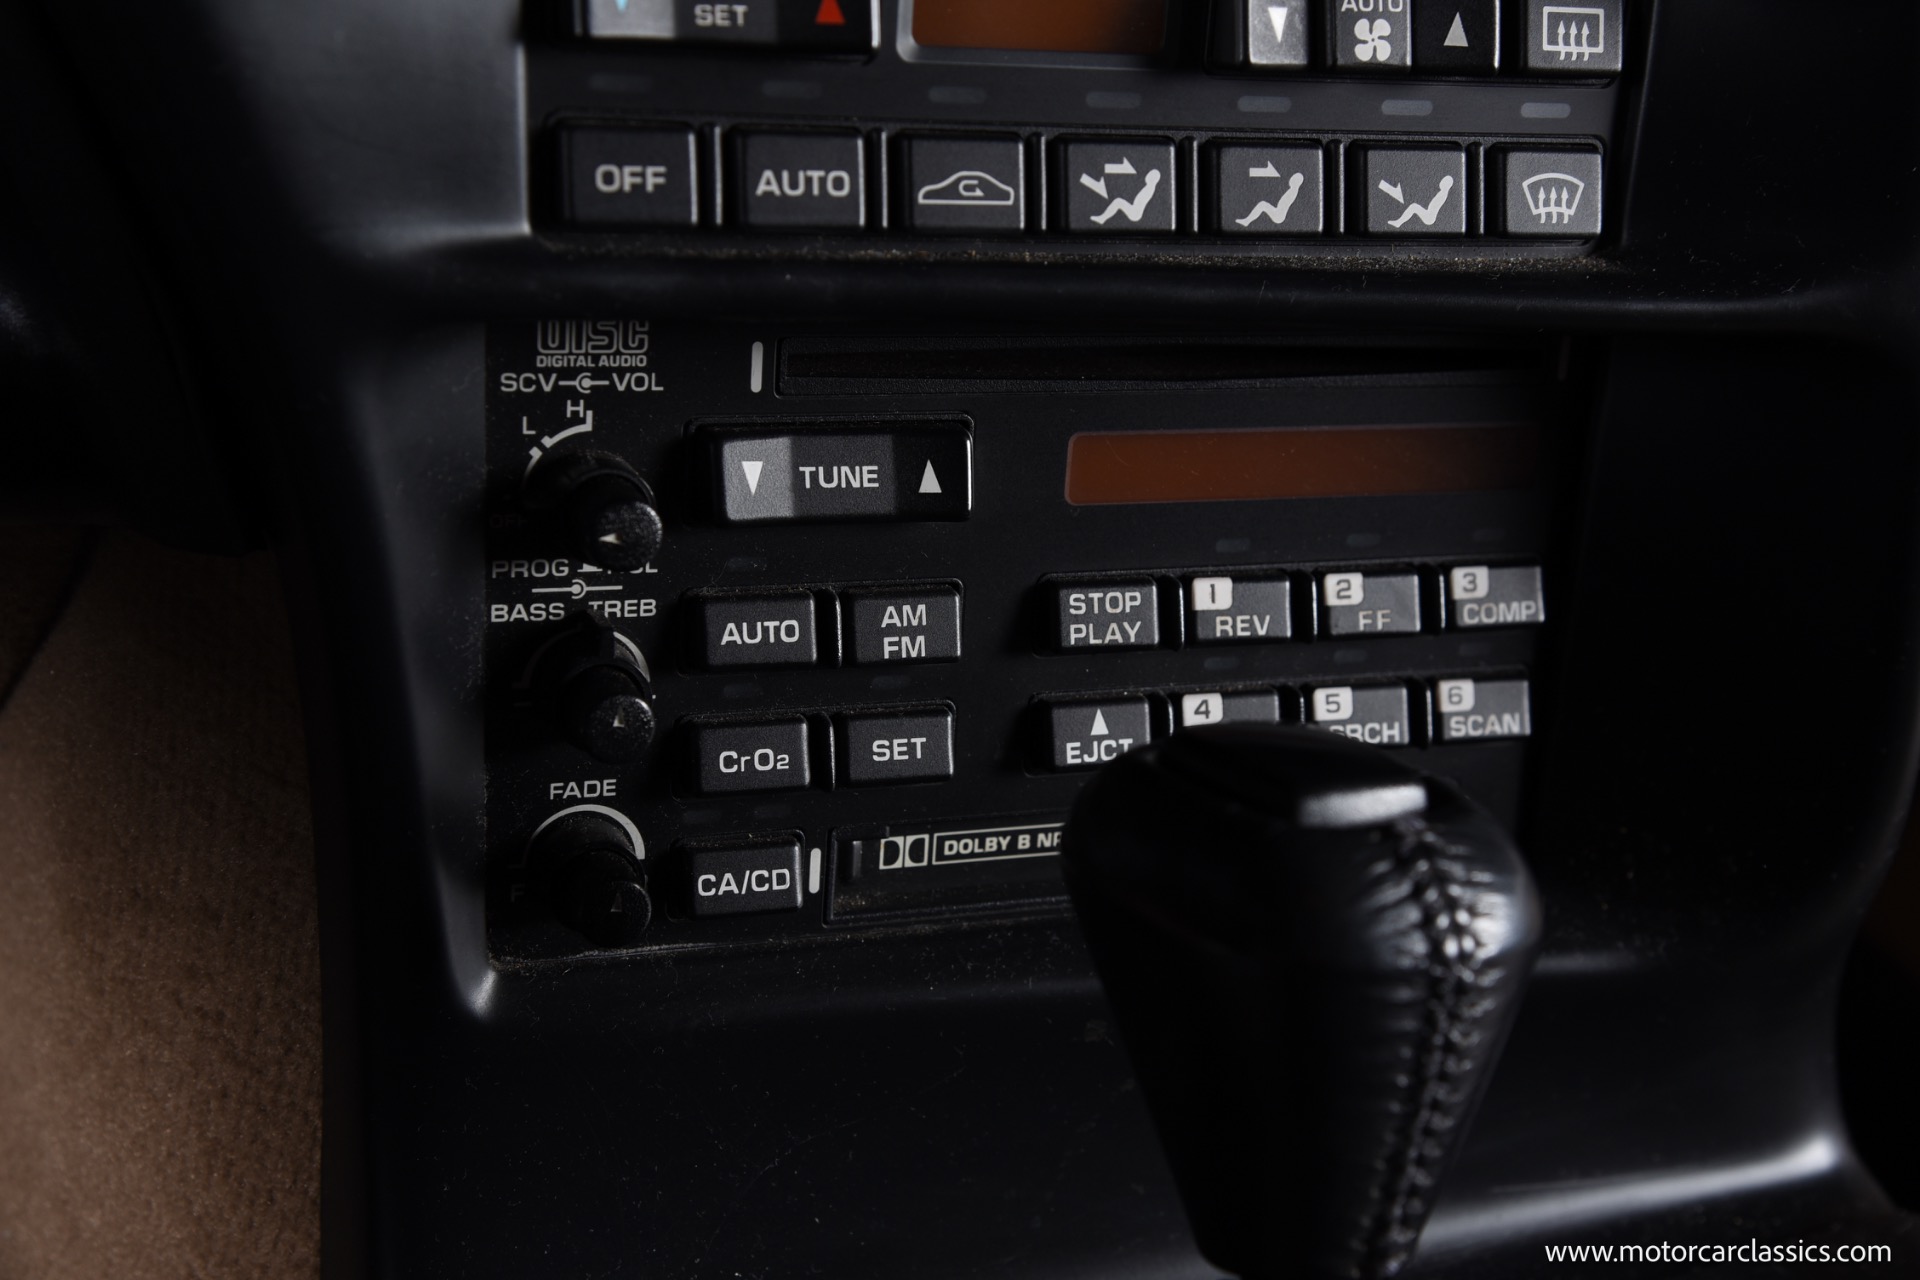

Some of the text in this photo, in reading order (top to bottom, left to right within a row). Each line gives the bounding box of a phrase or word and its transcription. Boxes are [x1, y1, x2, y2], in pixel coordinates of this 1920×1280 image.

[694, 4, 749, 27] SET
[594, 164, 667, 193] OFF
[755, 169, 851, 197] AUTO
[536, 354, 648, 368] DIGITAL AUDIO
[500, 372, 664, 392] SCV VOL
[566, 399, 584, 418] H
[522, 415, 536, 435] L
[799, 465, 879, 489] TUNE
[491, 558, 570, 579] PROG
[1210, 583, 1216, 604] 1
[1336, 579, 1351, 600] 2
[1463, 572, 1478, 592] 3
[490, 602, 565, 623] BASS
[1069, 591, 1142, 615] STOP
[1463, 600, 1537, 624] COMP
[881, 604, 927, 628] AM
[1215, 615, 1270, 637] REV
[1358, 609, 1391, 632] FF
[720, 619, 800, 646] AUTO
[1070, 621, 1142, 645] PLAY
[883, 635, 926, 660] FM
[1325, 693, 1341, 713] 5
[1448, 686, 1463, 705] 6
[1194, 699, 1211, 720] 4
[1450, 712, 1521, 738] SCAN
[872, 737, 927, 762] SET
[550, 779, 617, 800] FADE
[943, 834, 1011, 857] DOLBY
[1017, 833, 1031, 850] B
[697, 868, 790, 897] CA/CD
